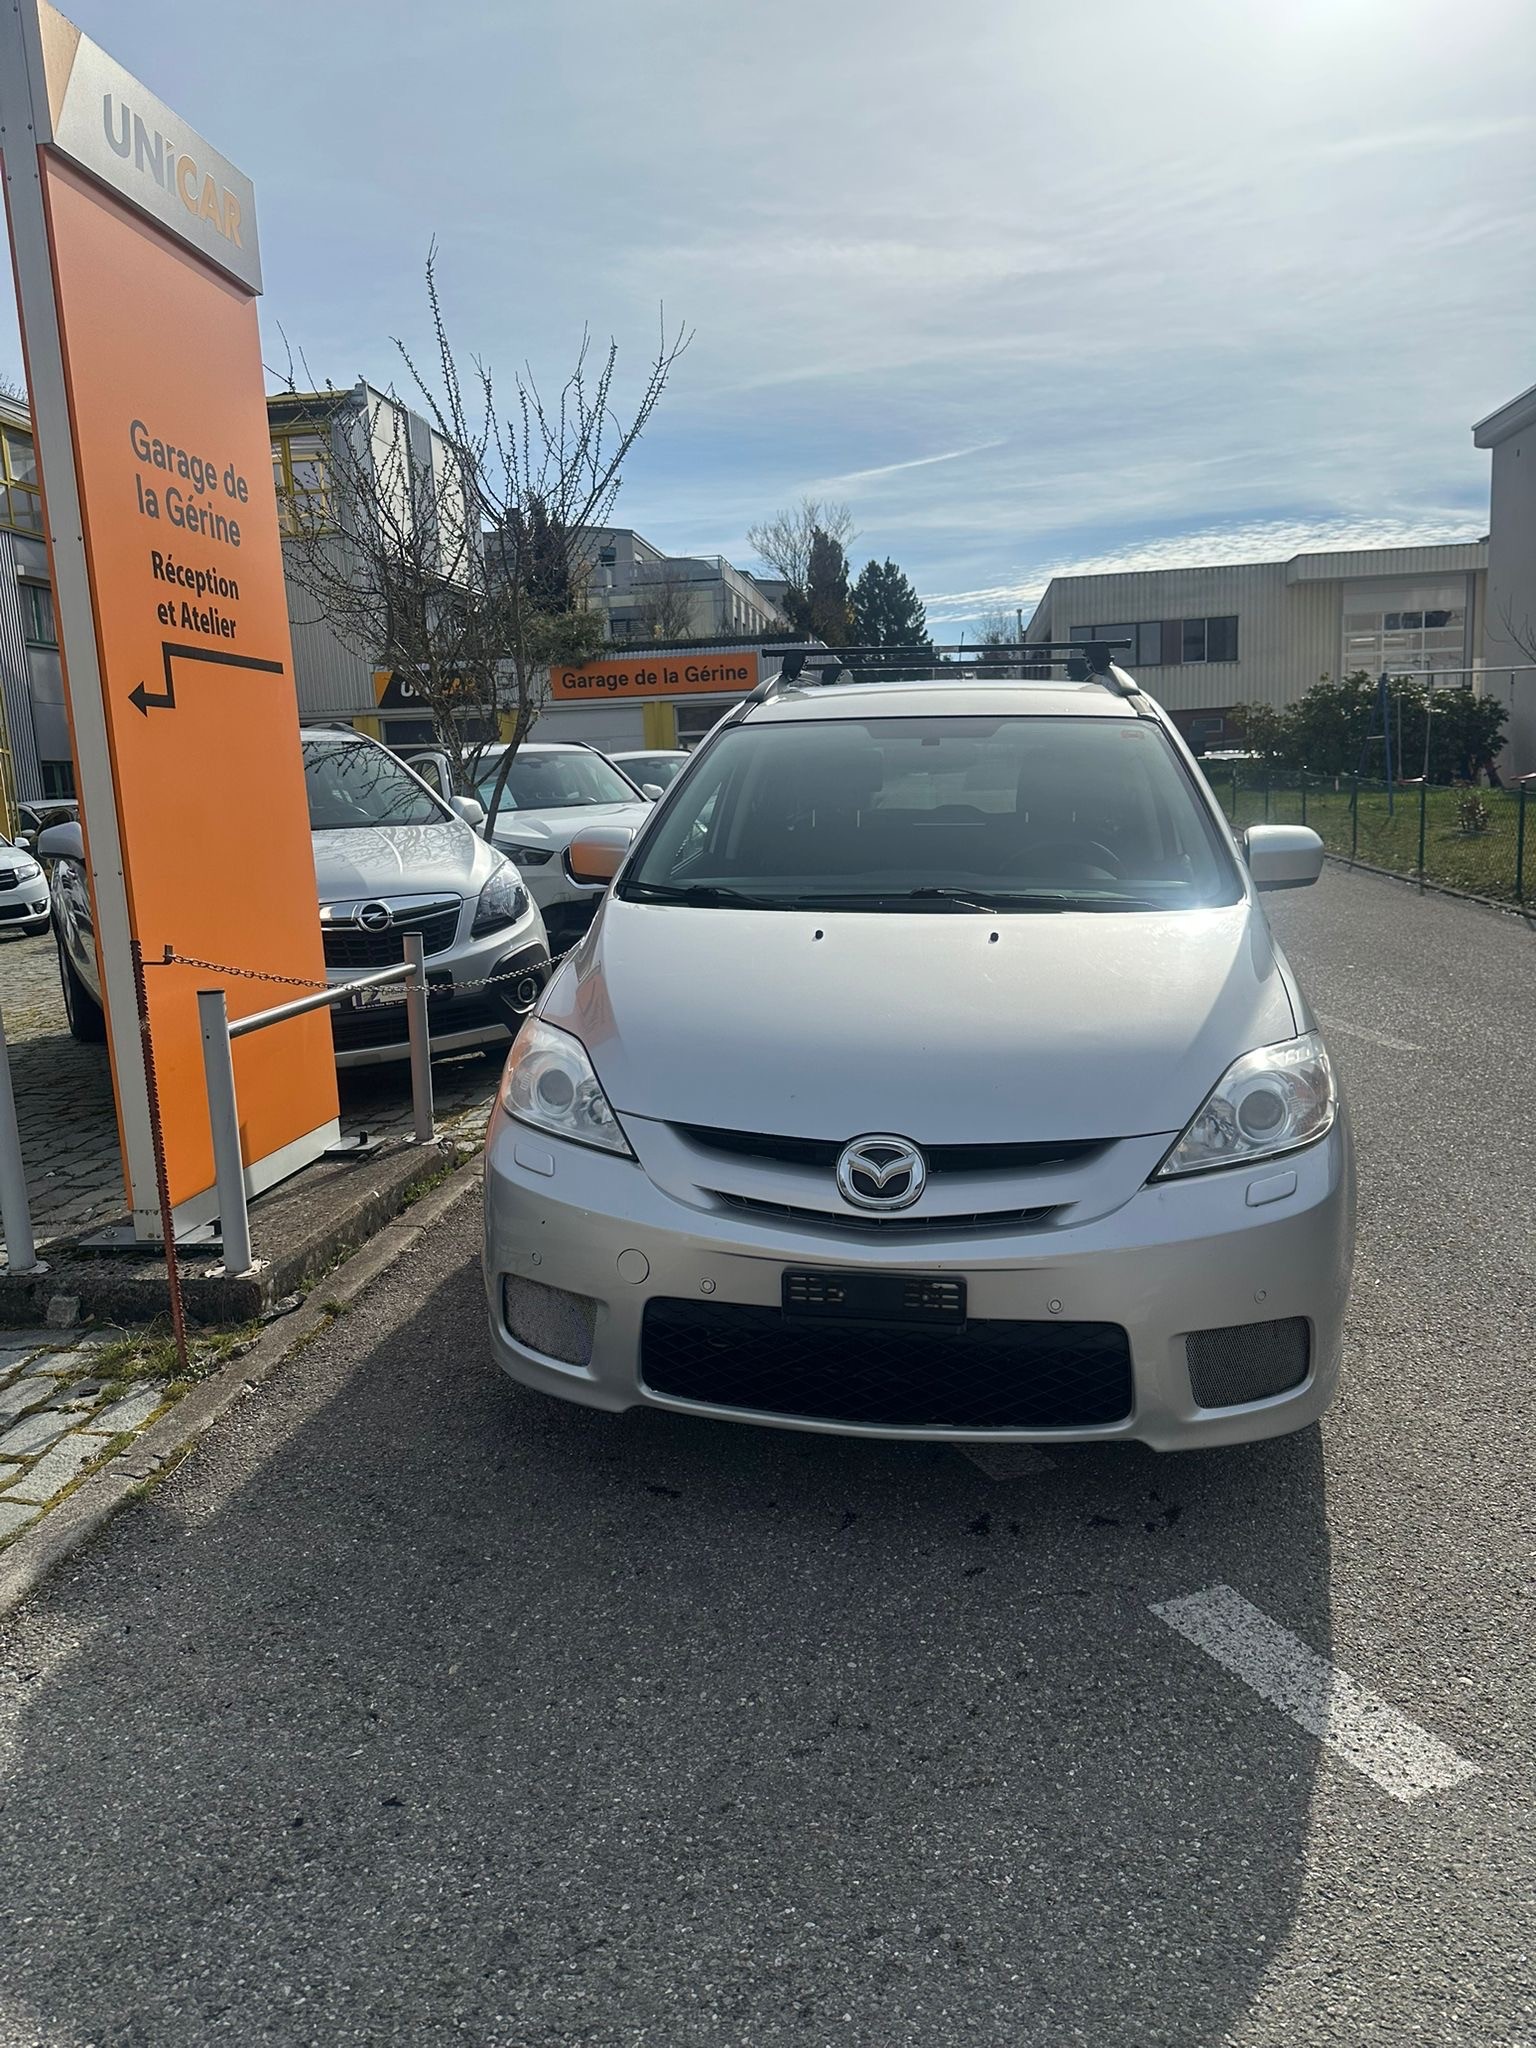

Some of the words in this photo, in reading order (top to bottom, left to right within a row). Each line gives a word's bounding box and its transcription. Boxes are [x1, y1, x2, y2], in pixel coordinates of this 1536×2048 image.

[130, 419, 218, 495] Garage
[223, 463, 249, 503] de
[135, 473, 160, 520] la
[165, 486, 241, 547] Gérine
[151, 550, 240, 601] Réception
[157, 601, 177, 627] et
[181, 601, 237, 639] Atelier
[562, 672, 629, 691] Garage
[634, 669, 657, 686] de
[663, 668, 679, 684] la
[684, 665, 749, 682] Gérine
